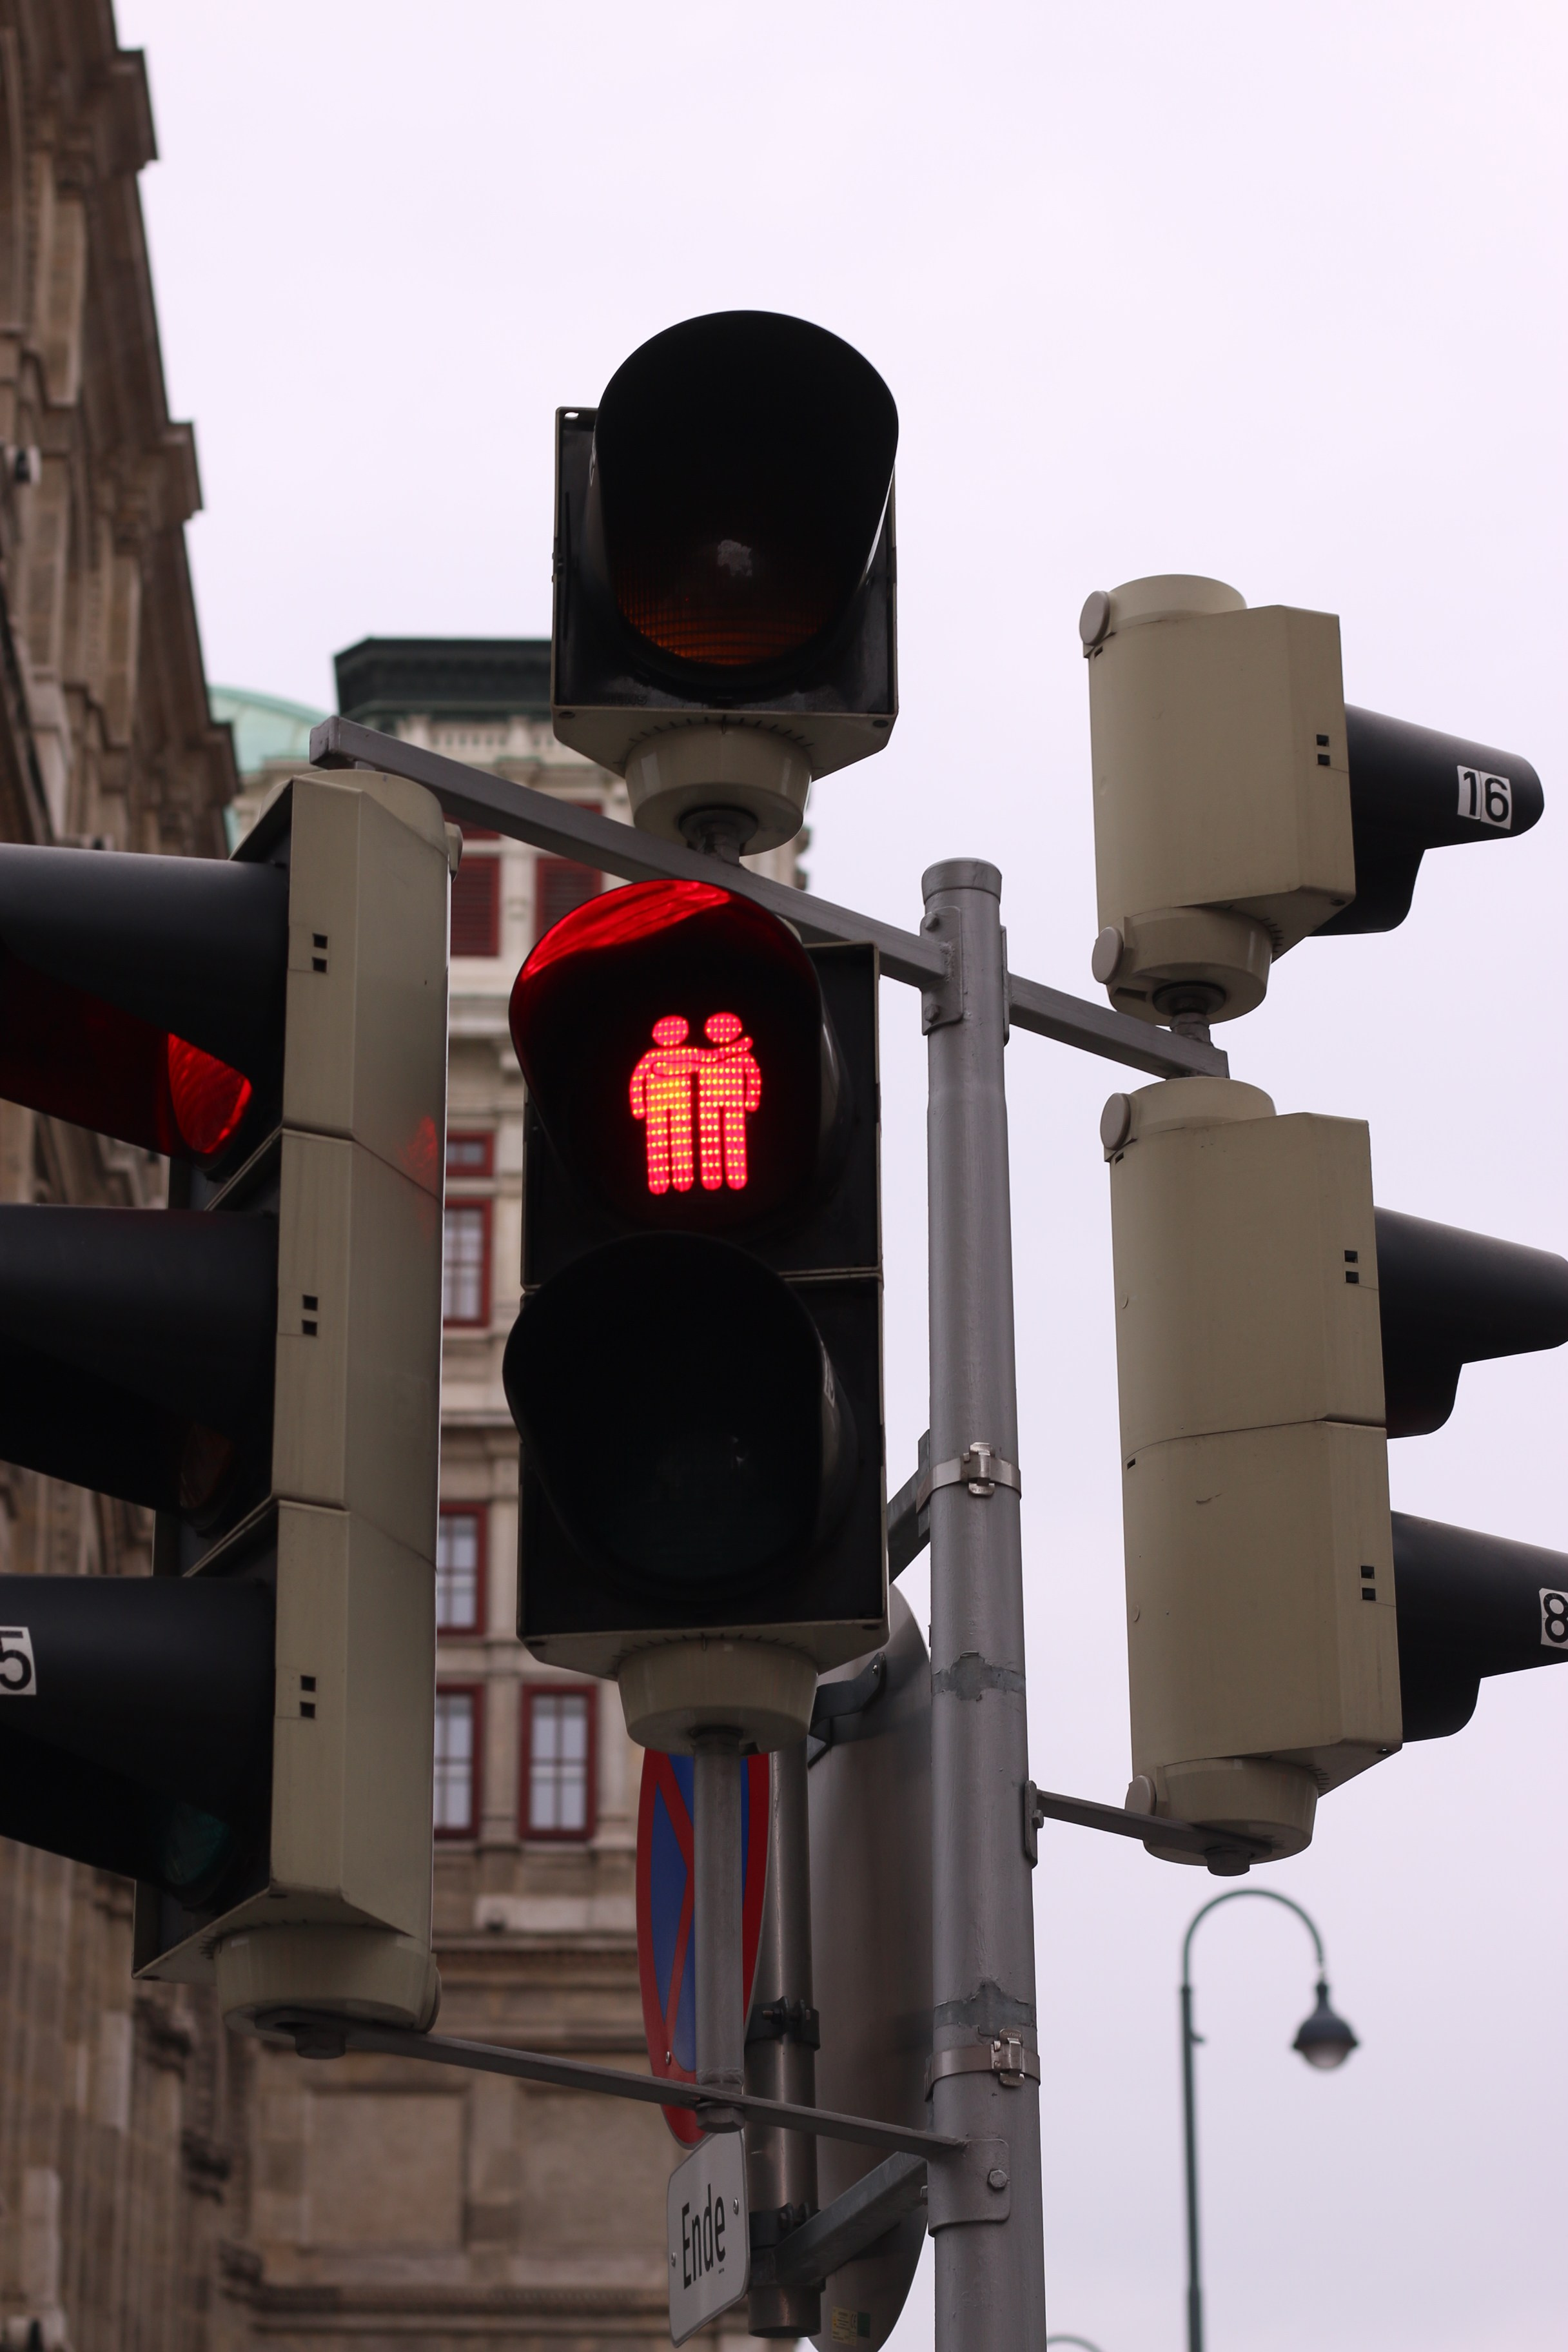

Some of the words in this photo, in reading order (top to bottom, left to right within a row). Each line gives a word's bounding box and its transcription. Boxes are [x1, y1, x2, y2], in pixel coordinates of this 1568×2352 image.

[1463, 770, 1509, 823] 16
[1543, 1592, 1568, 1643] 8
[0, 1631, 32, 1690] 5
[681, 2183, 726, 2289] Ende
